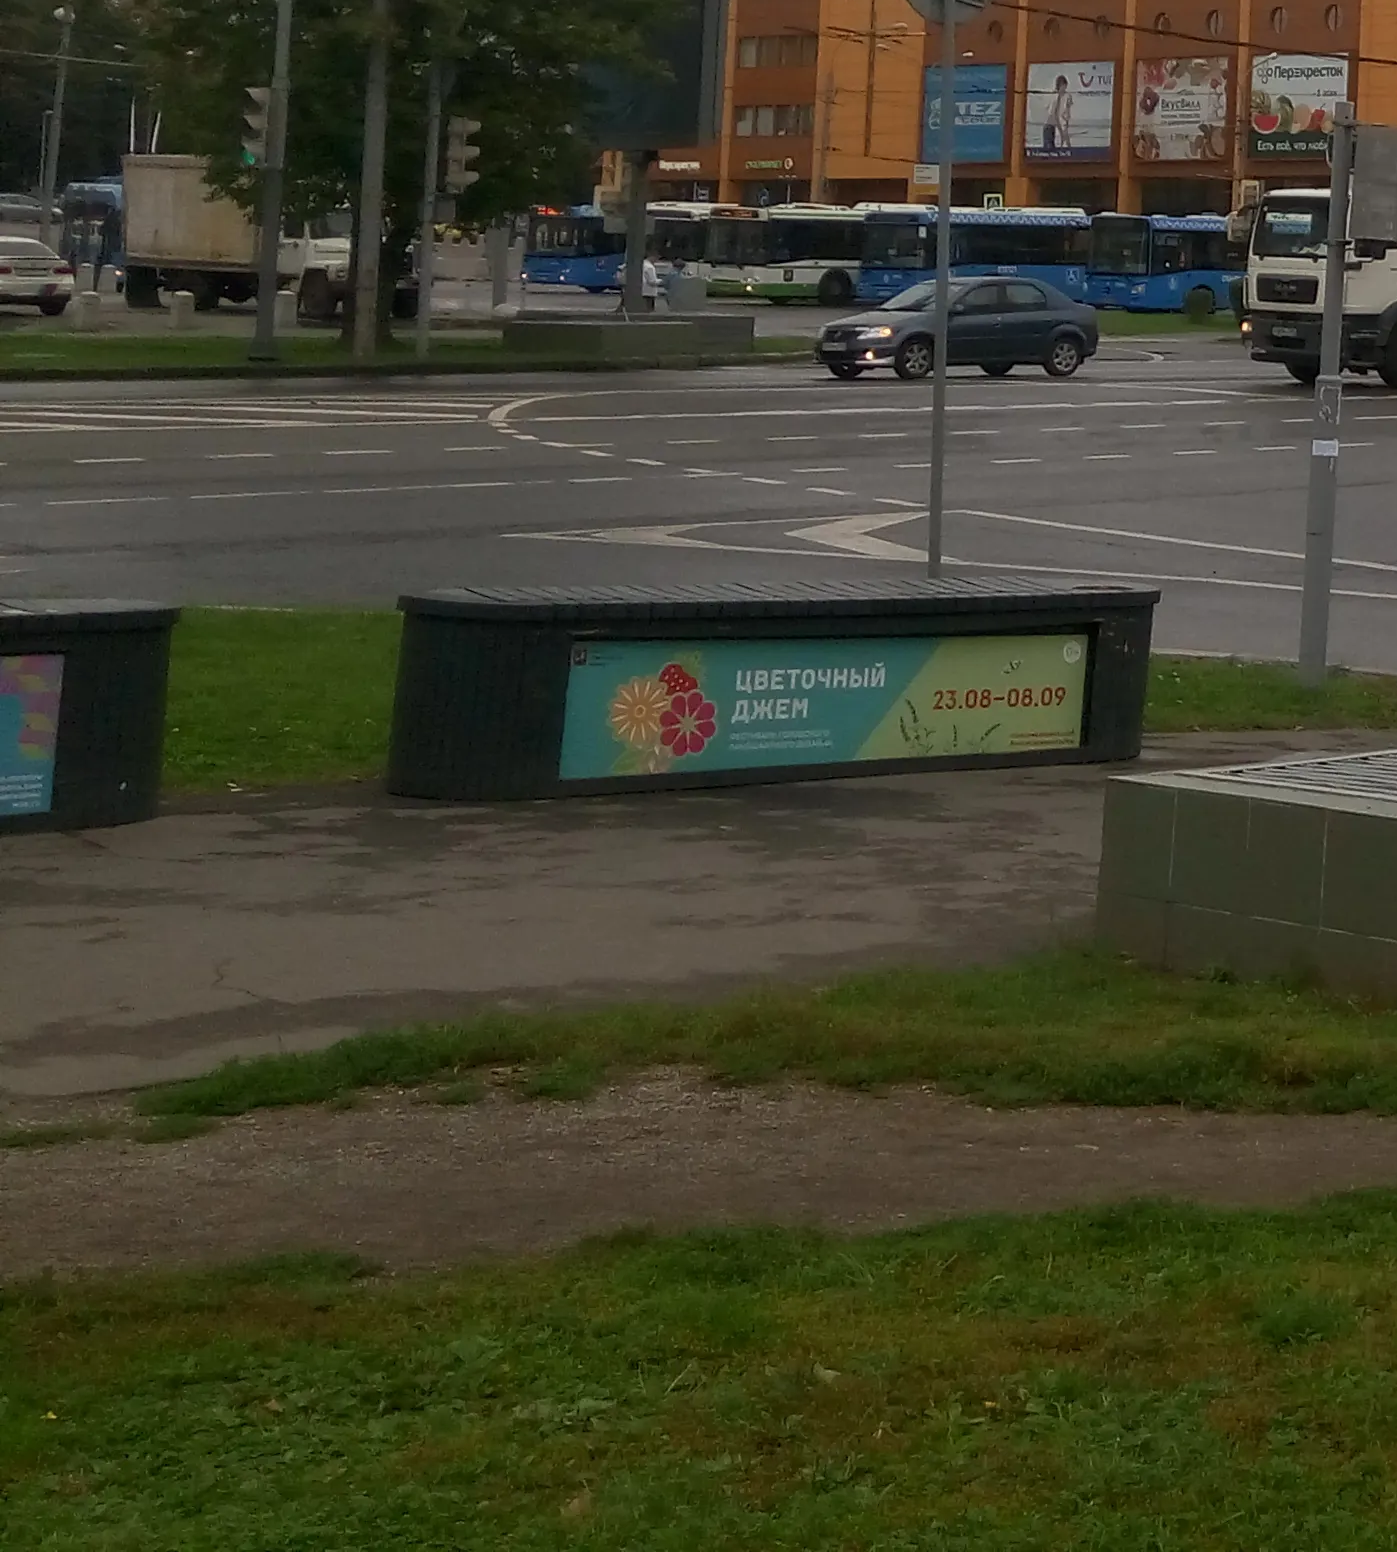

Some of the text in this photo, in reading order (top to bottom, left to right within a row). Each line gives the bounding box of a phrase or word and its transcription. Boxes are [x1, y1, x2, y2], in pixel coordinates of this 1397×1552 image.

[955, 101, 1001, 116] TEZ
[736, 662, 887, 694] ЦВЕТОЧНЫЙ
[731, 698, 809, 724] ДЖЕМ
[932, 686, 1067, 711] 23.08-08.09
